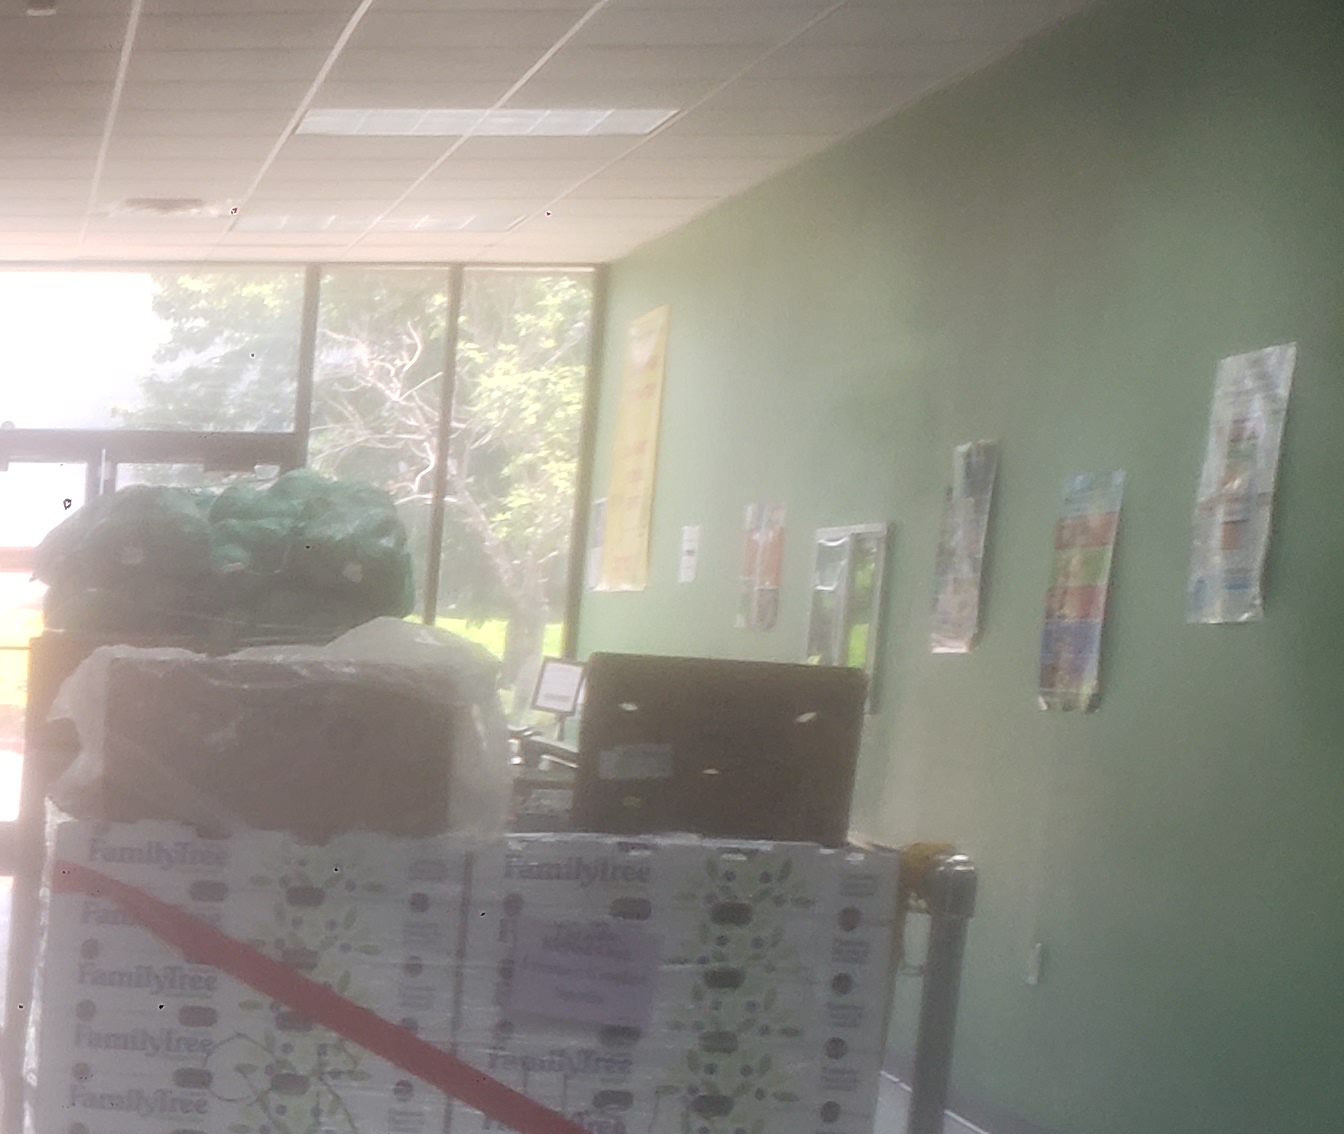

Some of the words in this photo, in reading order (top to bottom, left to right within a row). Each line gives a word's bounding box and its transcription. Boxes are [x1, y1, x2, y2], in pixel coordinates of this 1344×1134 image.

[89, 838, 226, 868] FamilyTree
[504, 855, 651, 888] FamilyTree
[77, 962, 218, 995] FamilyTree
[76, 1026, 214, 1058] FamilyTree
[70, 1087, 209, 1119] FamilyTree
